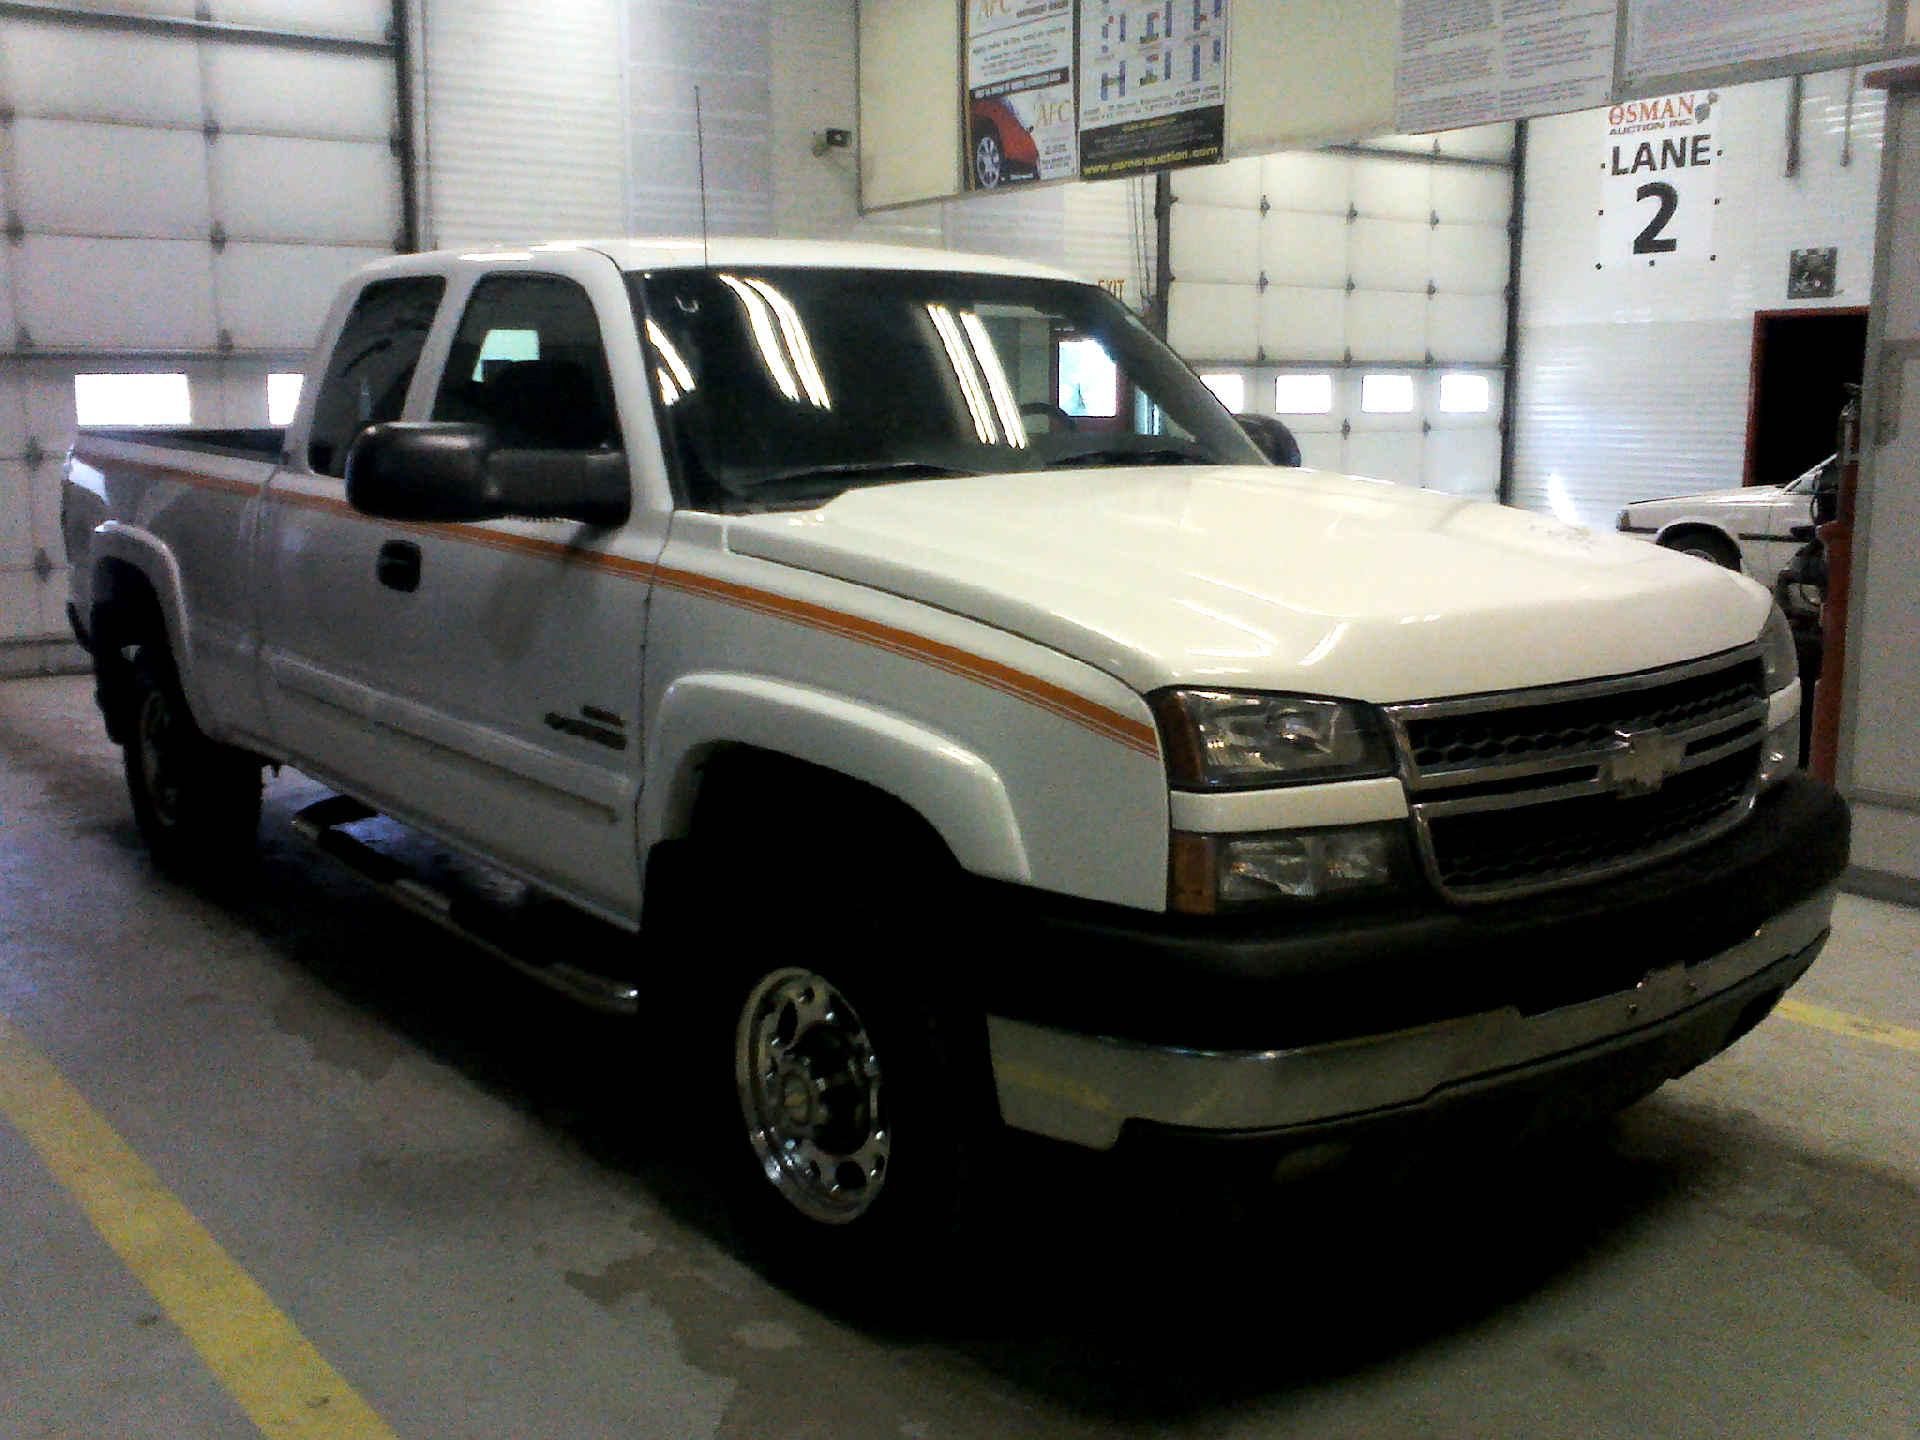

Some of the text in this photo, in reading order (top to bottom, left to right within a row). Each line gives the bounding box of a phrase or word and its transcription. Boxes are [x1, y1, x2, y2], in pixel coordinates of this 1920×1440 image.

[1036, 99, 1071, 127] AFC
[1608, 94, 1695, 125] OSMAN
[1609, 121, 1665, 135] AUCTION
[1612, 134, 1711, 175] LANE
[1633, 181, 1678, 254] 2
